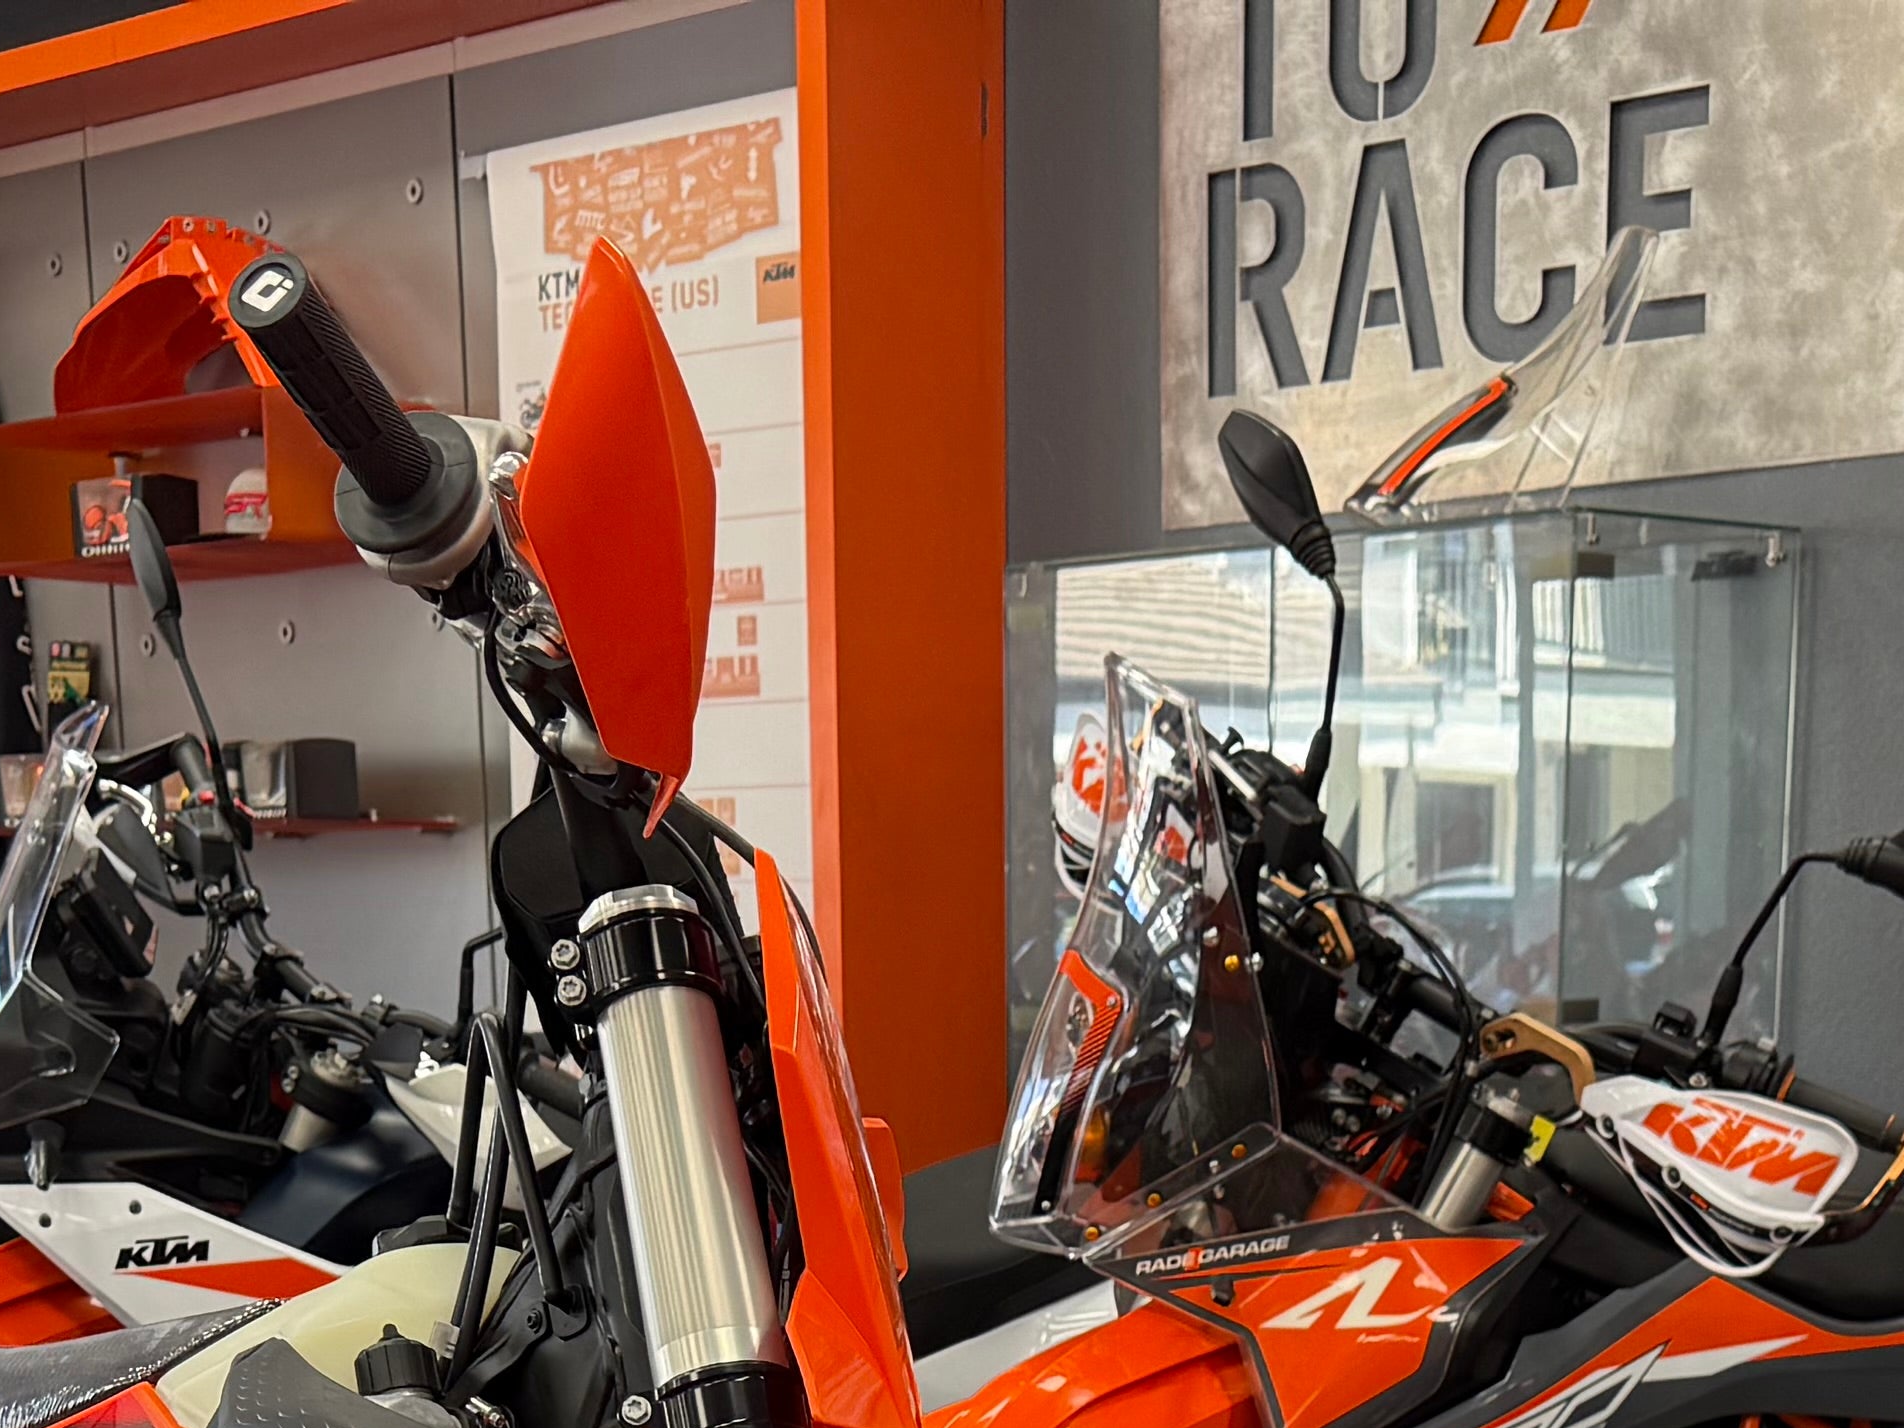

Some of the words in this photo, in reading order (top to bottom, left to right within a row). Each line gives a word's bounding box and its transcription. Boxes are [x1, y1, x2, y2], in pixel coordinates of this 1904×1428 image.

[1207, 84, 1711, 399] RACE
[537, 268, 580, 302] KTM
[762, 262, 797, 284] KTM
[670, 273, 720, 314] (US)
[1642, 1096, 1841, 1198] KTM
[114, 1235, 210, 1270] KTM
[1198, 1234, 1291, 1265] GARAGE
